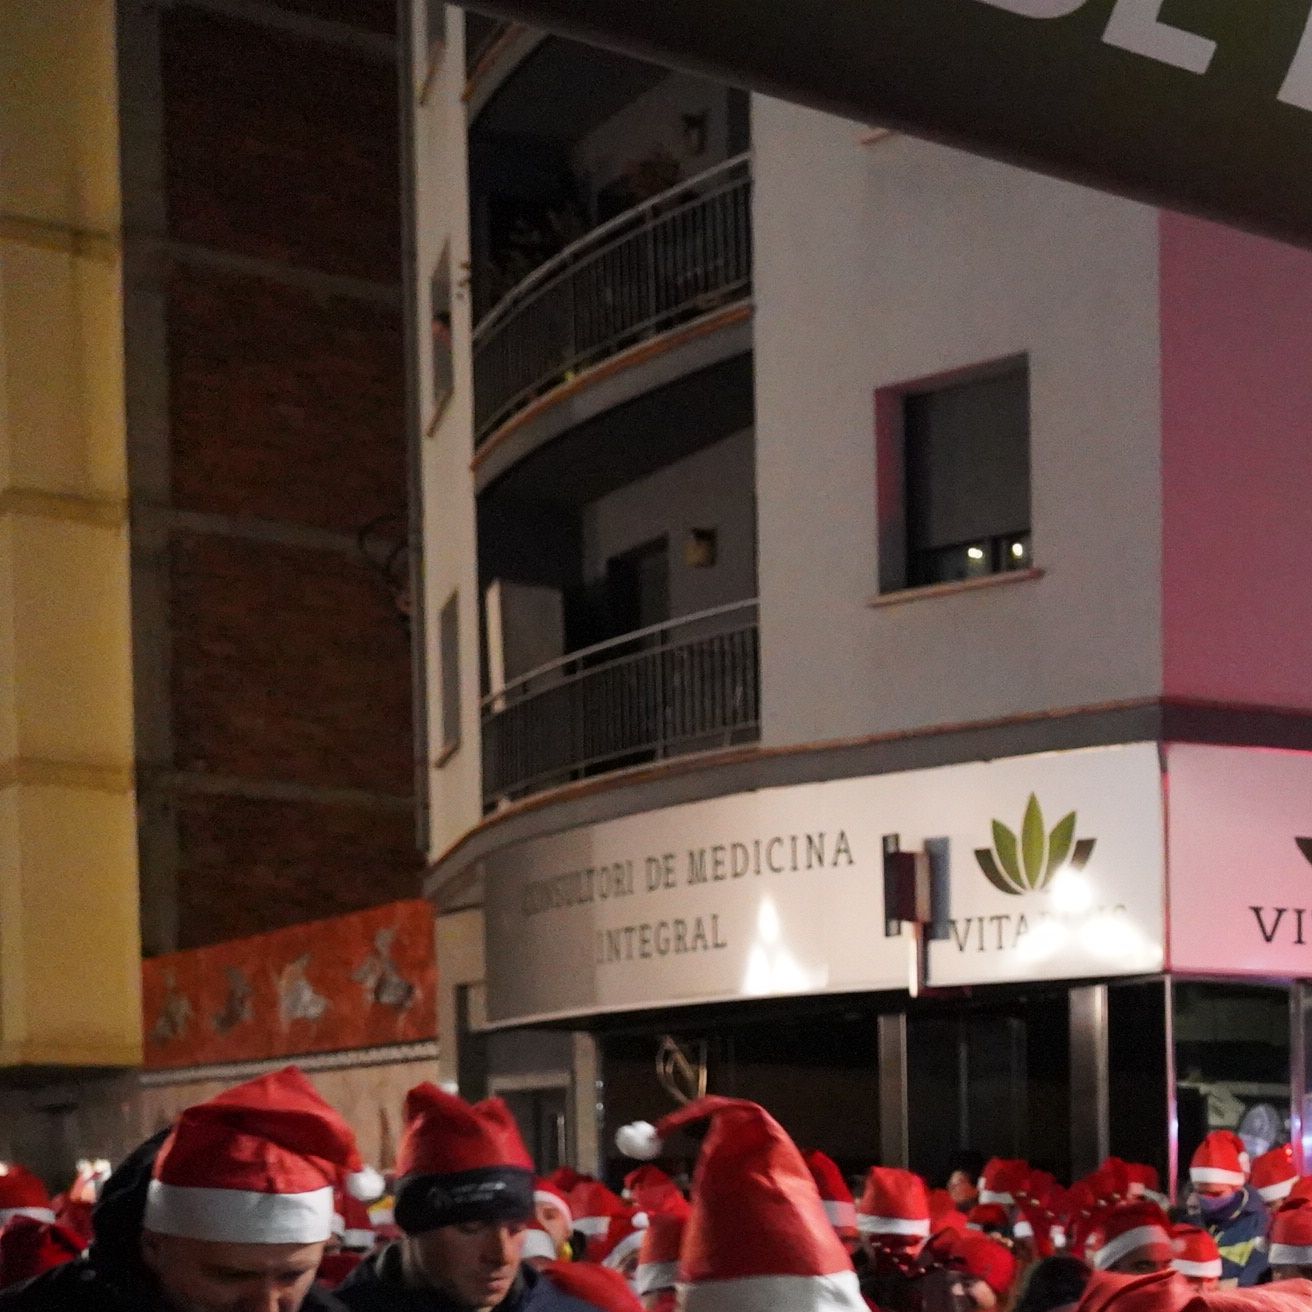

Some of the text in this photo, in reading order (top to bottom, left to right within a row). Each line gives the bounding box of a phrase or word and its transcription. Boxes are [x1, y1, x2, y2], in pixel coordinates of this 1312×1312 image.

[645, 853, 677, 892] DE
[688, 829, 855, 884] MEDICINA
[597, 913, 728, 963] INTEGRAL
